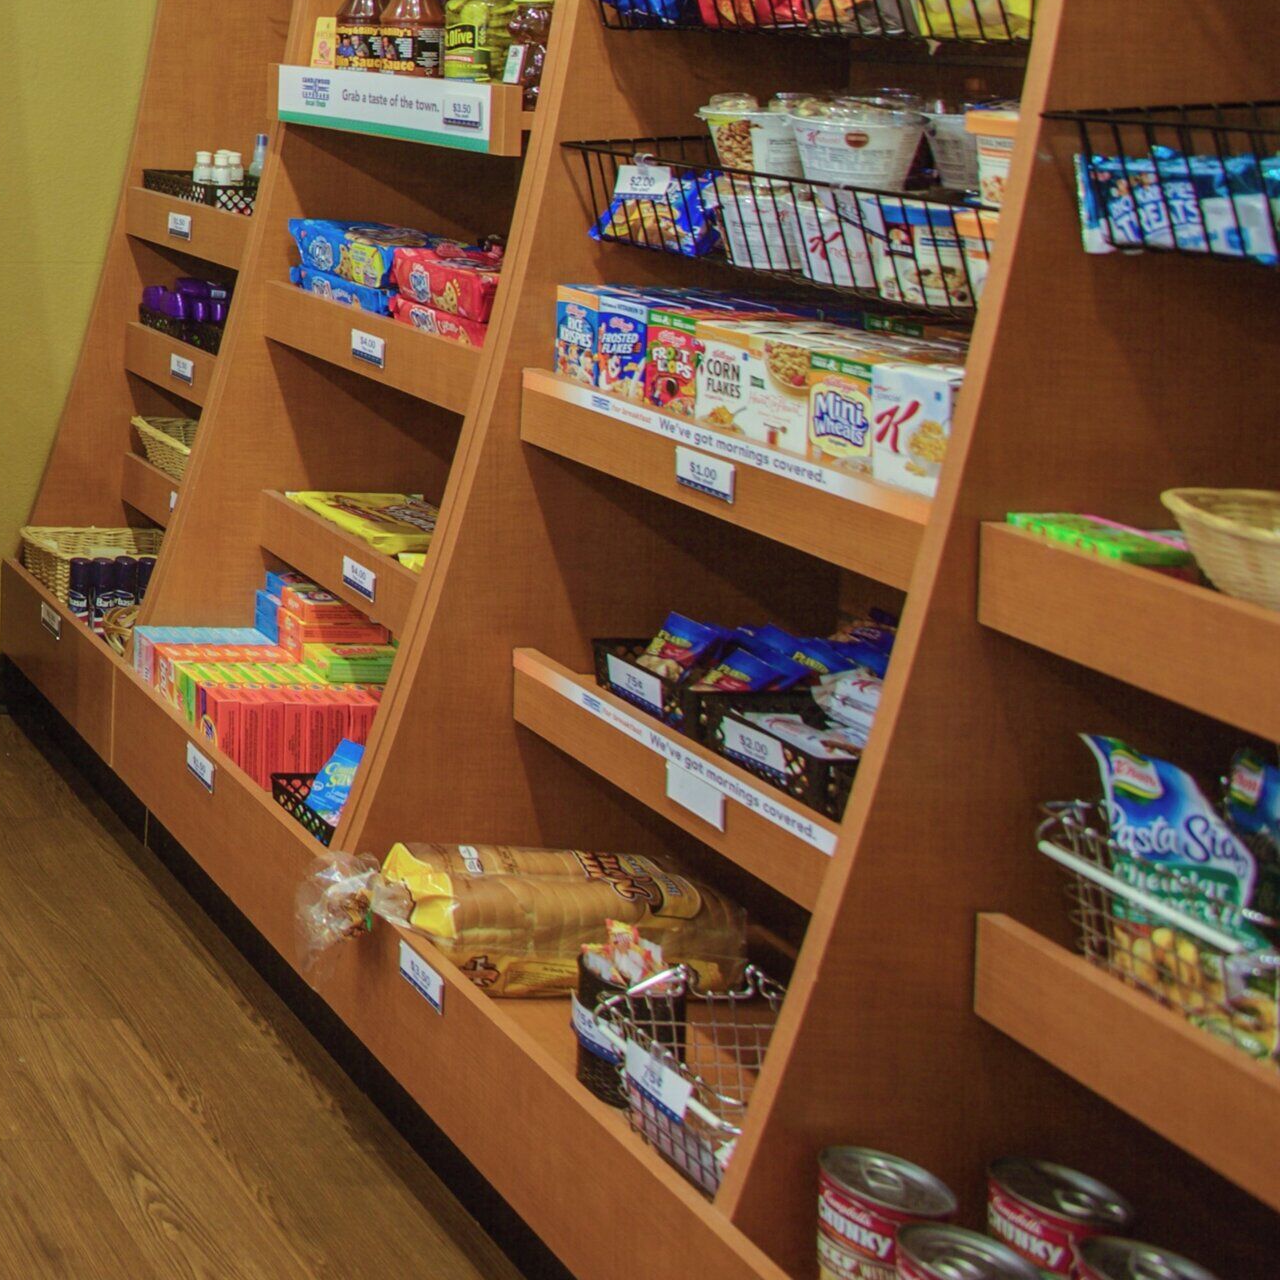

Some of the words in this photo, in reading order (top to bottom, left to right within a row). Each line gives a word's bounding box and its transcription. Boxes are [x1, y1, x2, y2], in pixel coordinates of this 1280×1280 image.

[449, 29, 474, 47] Olive
[341, 88, 360, 103] Grab
[361, 94, 367, 103] a
[368, 94, 388, 107] taste
[389, 94, 398, 108] of
[400, 97, 414, 110] the
[415, 100, 441, 113] town.
[452, 102, 472, 114] $3.50
[567, 316, 584, 332] RICE
[359, 336, 377, 350] $4.00
[559, 326, 592, 349] KRISPIES
[601, 330, 639, 345] FROSTED
[601, 341, 633, 355] FLAKES
[652, 346, 689, 364] FROOT
[657, 358, 692, 379] LOOPS
[706, 358, 741, 382] CORN
[706, 377, 741, 400] FLAKES
[813, 415, 866, 447] Wheats
[874, 399, 921, 454] K
[659, 417, 690, 441] We've
[693, 430, 714, 448] got
[715, 438, 770, 467] mornings
[772, 457, 827, 486] covered.
[689, 460, 718, 482] $1.00
[738, 734, 769, 757] $2.00
[649, 731, 683, 761] We've
[683, 755, 705, 775] got
[706, 769, 760, 808] mornings
[762, 800, 817, 840] covered.
[1109, 804, 1179, 854] Pasta
[642, 1066, 664, 1090] 75¢
[818, 1194, 892, 1260] CHUNKY
[989, 1206, 1063, 1266] CHUNKY
